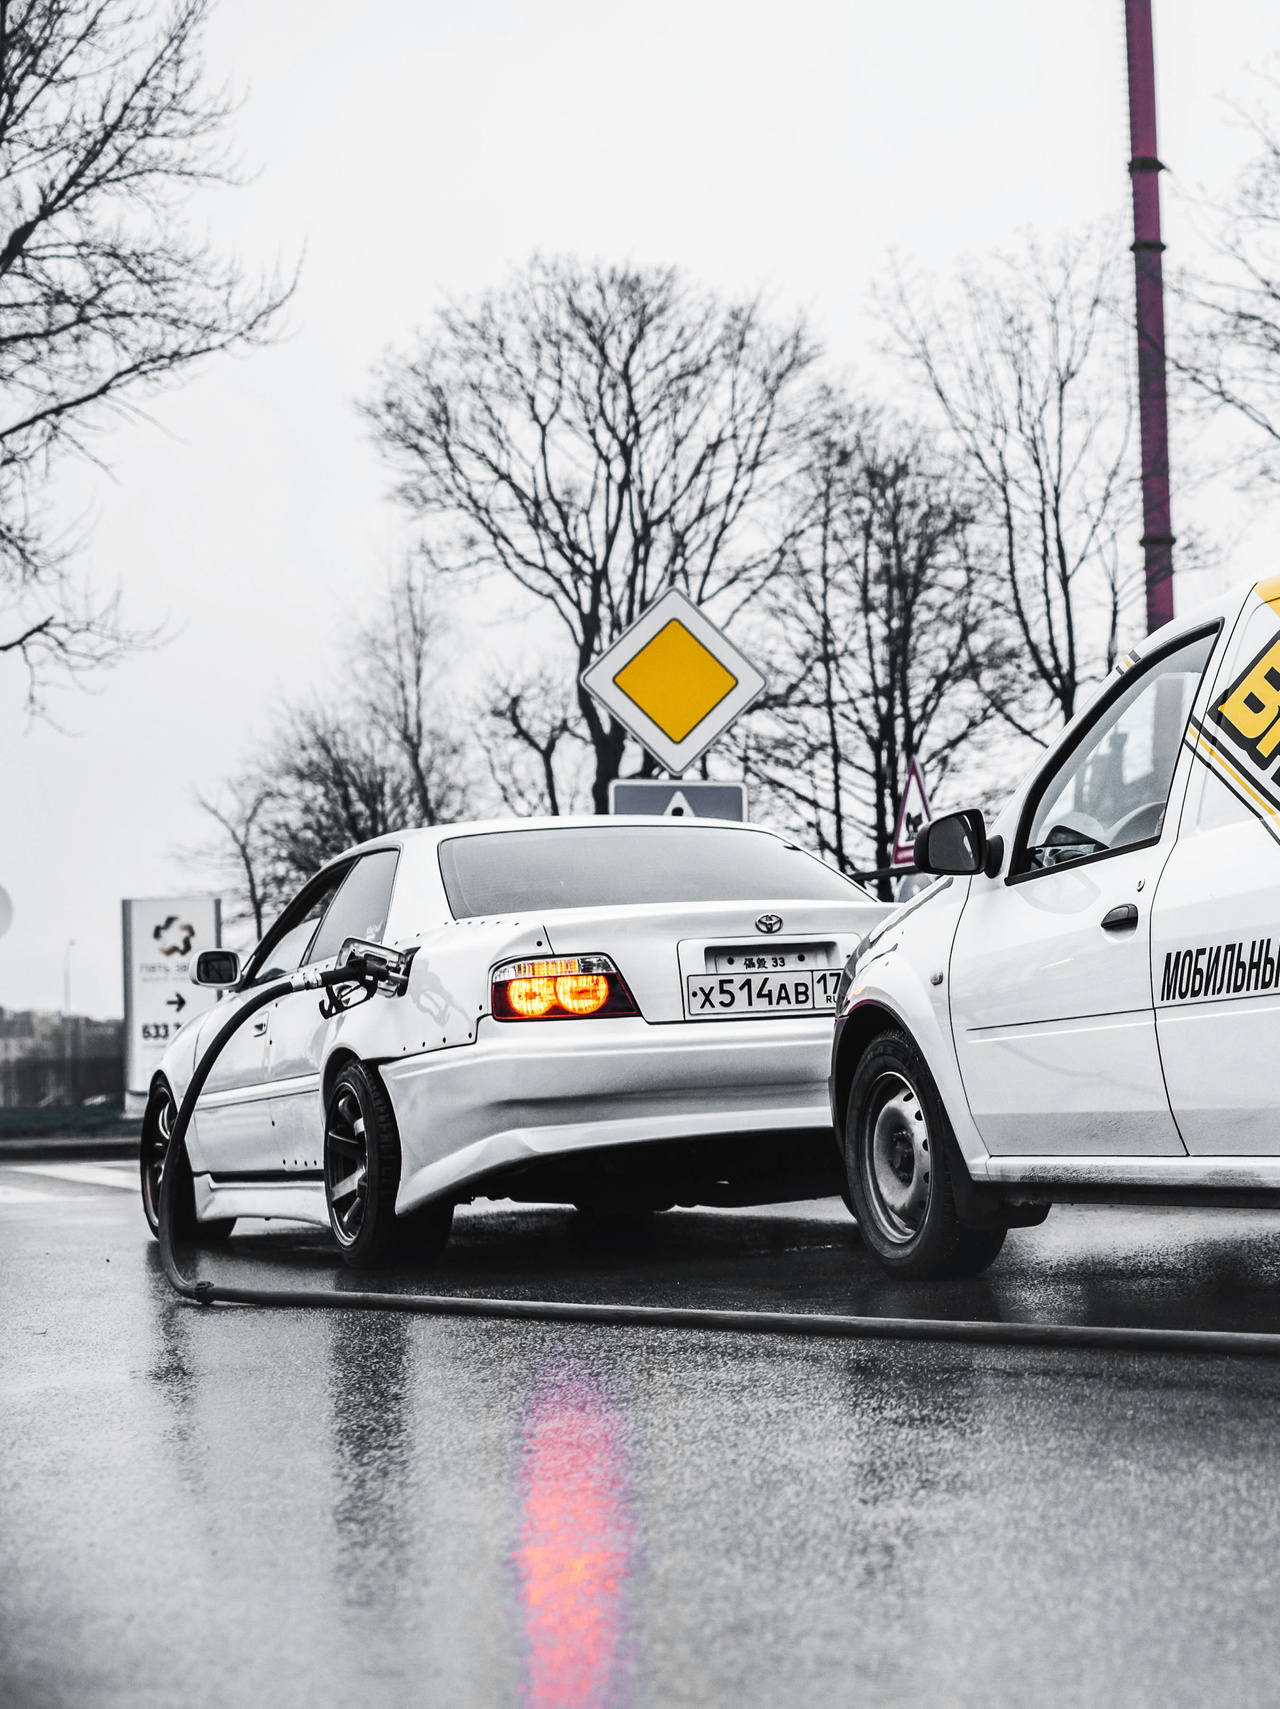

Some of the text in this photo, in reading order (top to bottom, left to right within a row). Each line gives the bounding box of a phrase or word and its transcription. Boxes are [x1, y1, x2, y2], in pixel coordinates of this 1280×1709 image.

[771, 957, 786, 968] 33
[816, 972, 841, 995] 17
[142, 1023, 169, 1040] 633
